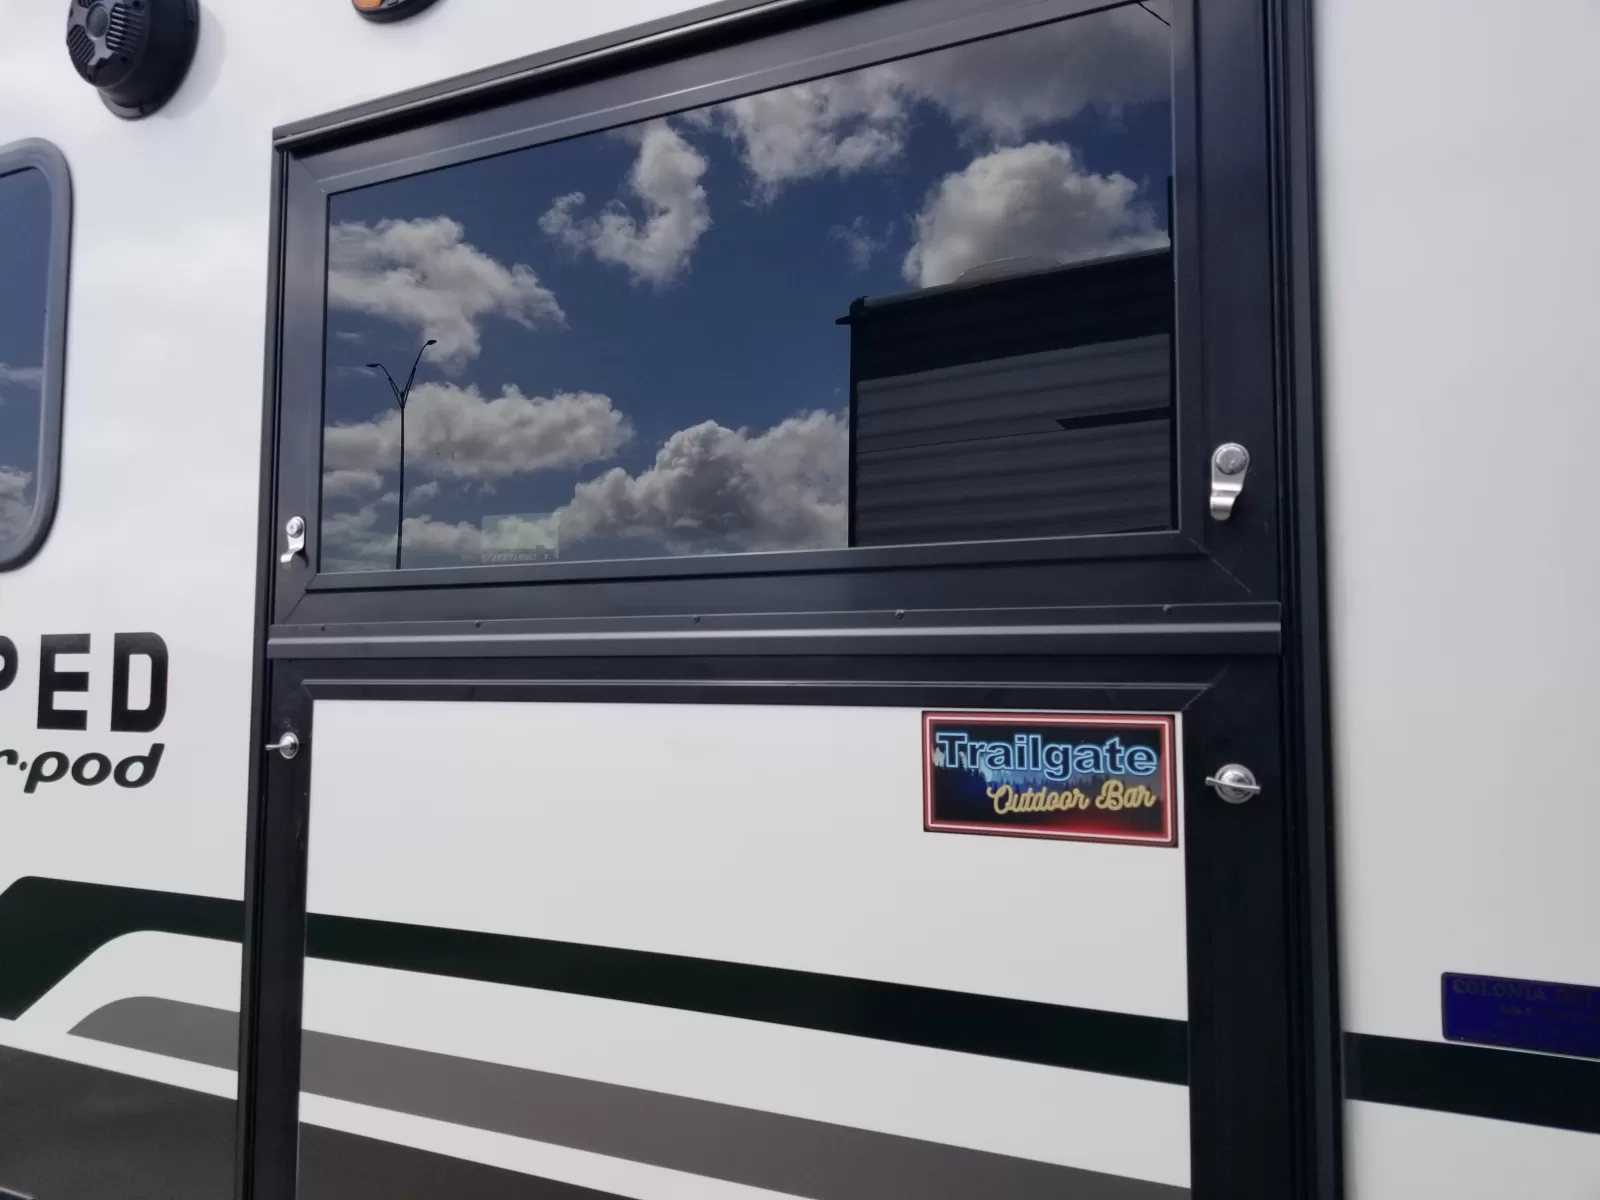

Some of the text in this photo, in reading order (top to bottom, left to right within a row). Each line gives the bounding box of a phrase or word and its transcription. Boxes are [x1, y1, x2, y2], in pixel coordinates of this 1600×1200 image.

[934, 731, 1158, 782] Trailgate
[986, 779, 1157, 815] Outdoor Bar
